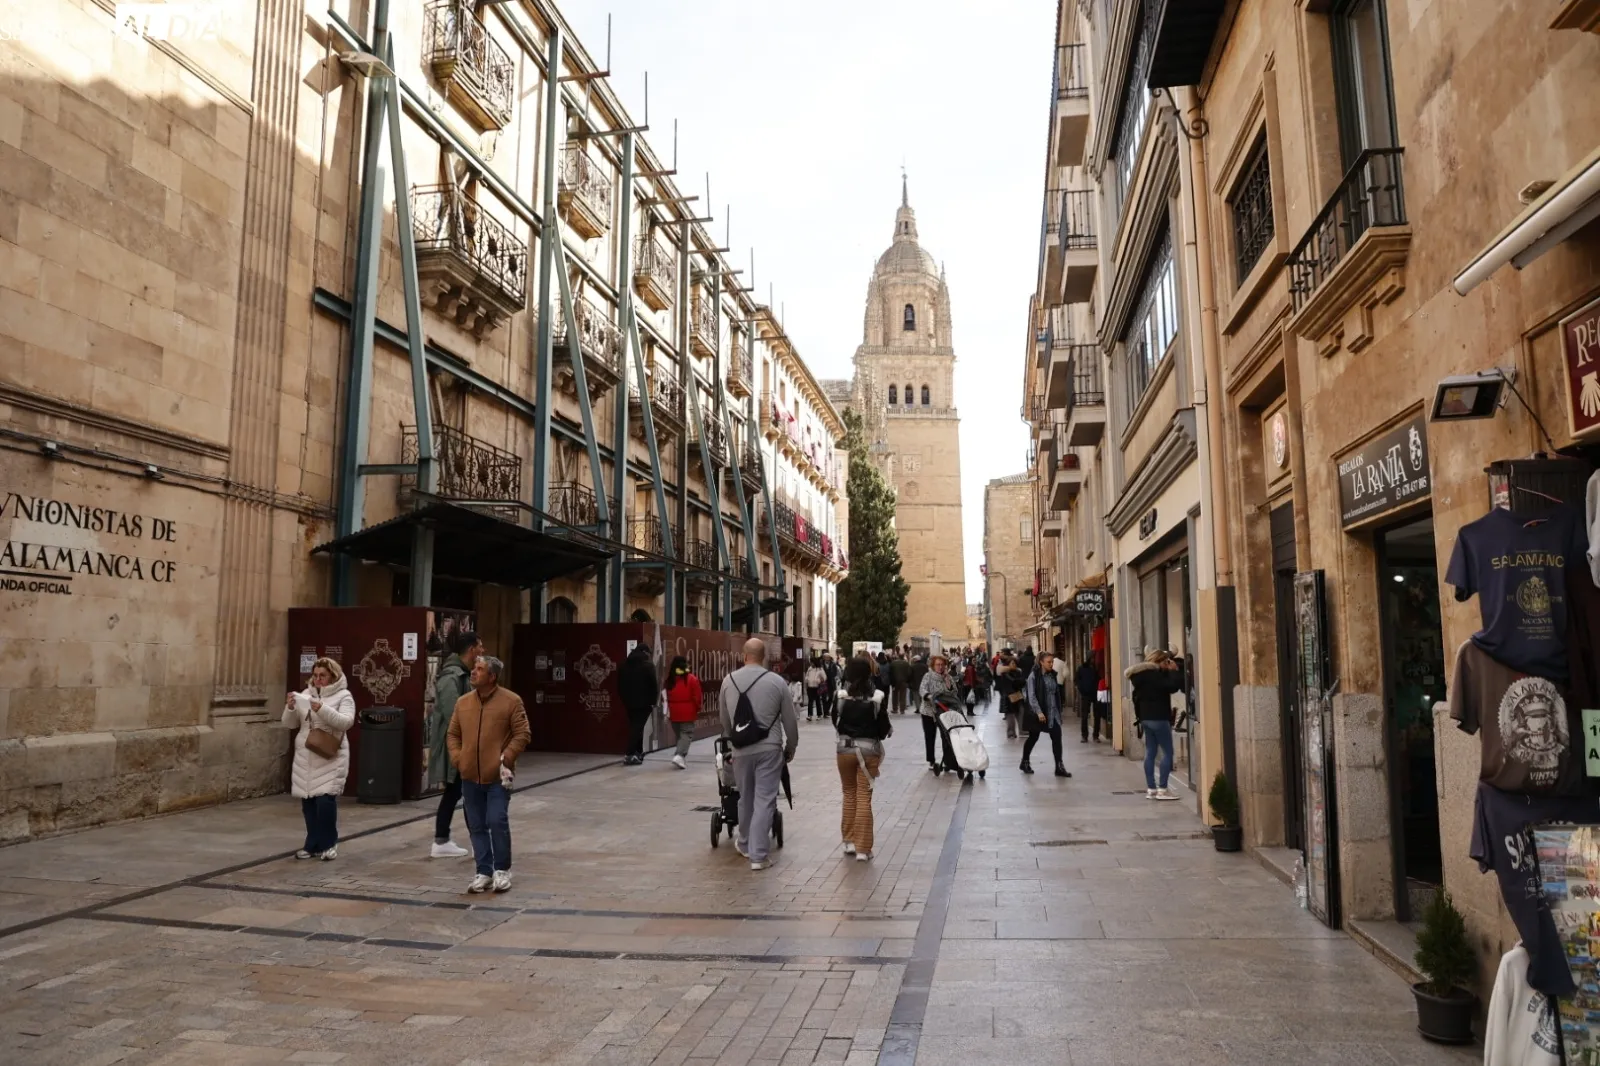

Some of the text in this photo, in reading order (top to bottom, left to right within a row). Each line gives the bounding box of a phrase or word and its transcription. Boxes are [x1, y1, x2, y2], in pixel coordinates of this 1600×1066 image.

[1339, 453, 1364, 477] REGALOS
[1352, 469, 1366, 500] LA
[151, 517, 176, 543] DE
[151, 559, 176, 583] CF
[29, 581, 72, 596] OFICIAL
[1076, 592, 1103, 603] REGALOS
